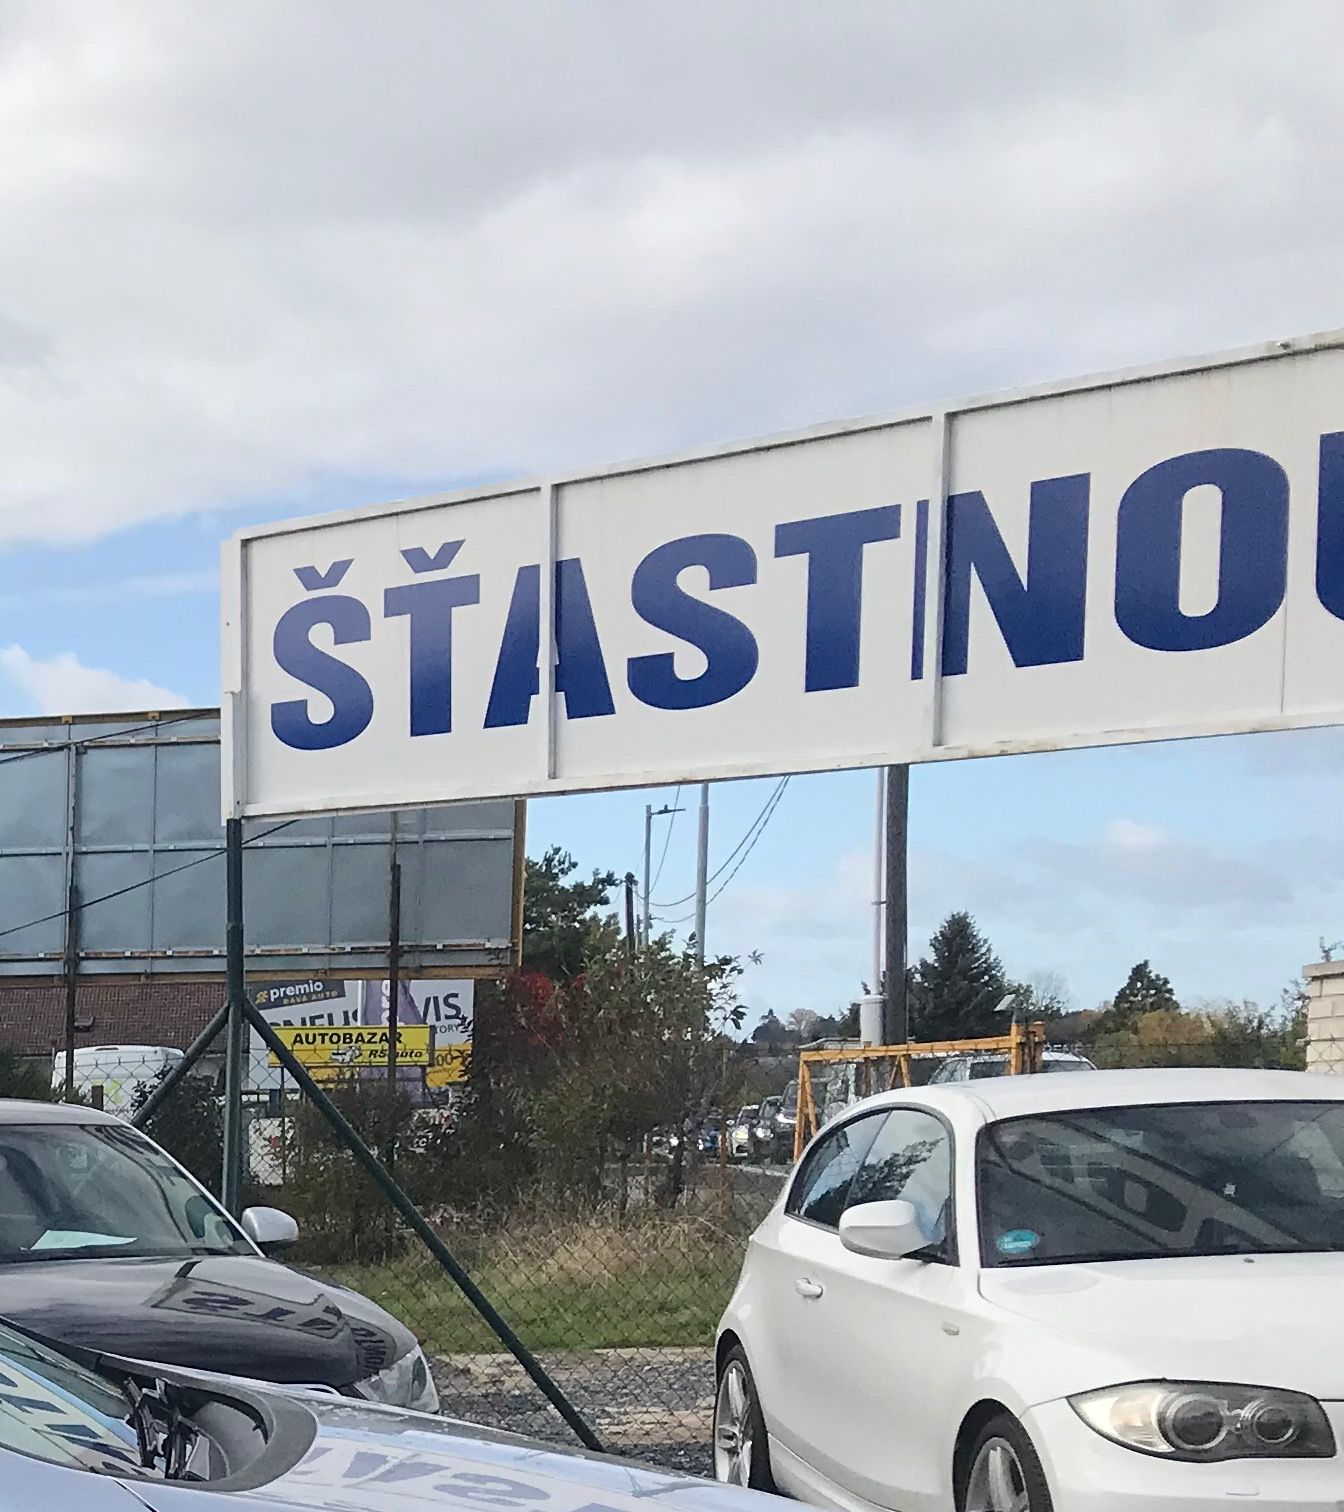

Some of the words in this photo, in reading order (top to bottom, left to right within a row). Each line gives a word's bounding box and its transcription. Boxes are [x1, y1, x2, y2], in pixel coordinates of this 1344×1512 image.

[270, 431, 1344, 751] ŠŤASTNO
[269, 980, 324, 1001] premio
[292, 1032, 403, 1045] AUTOBAZAR
